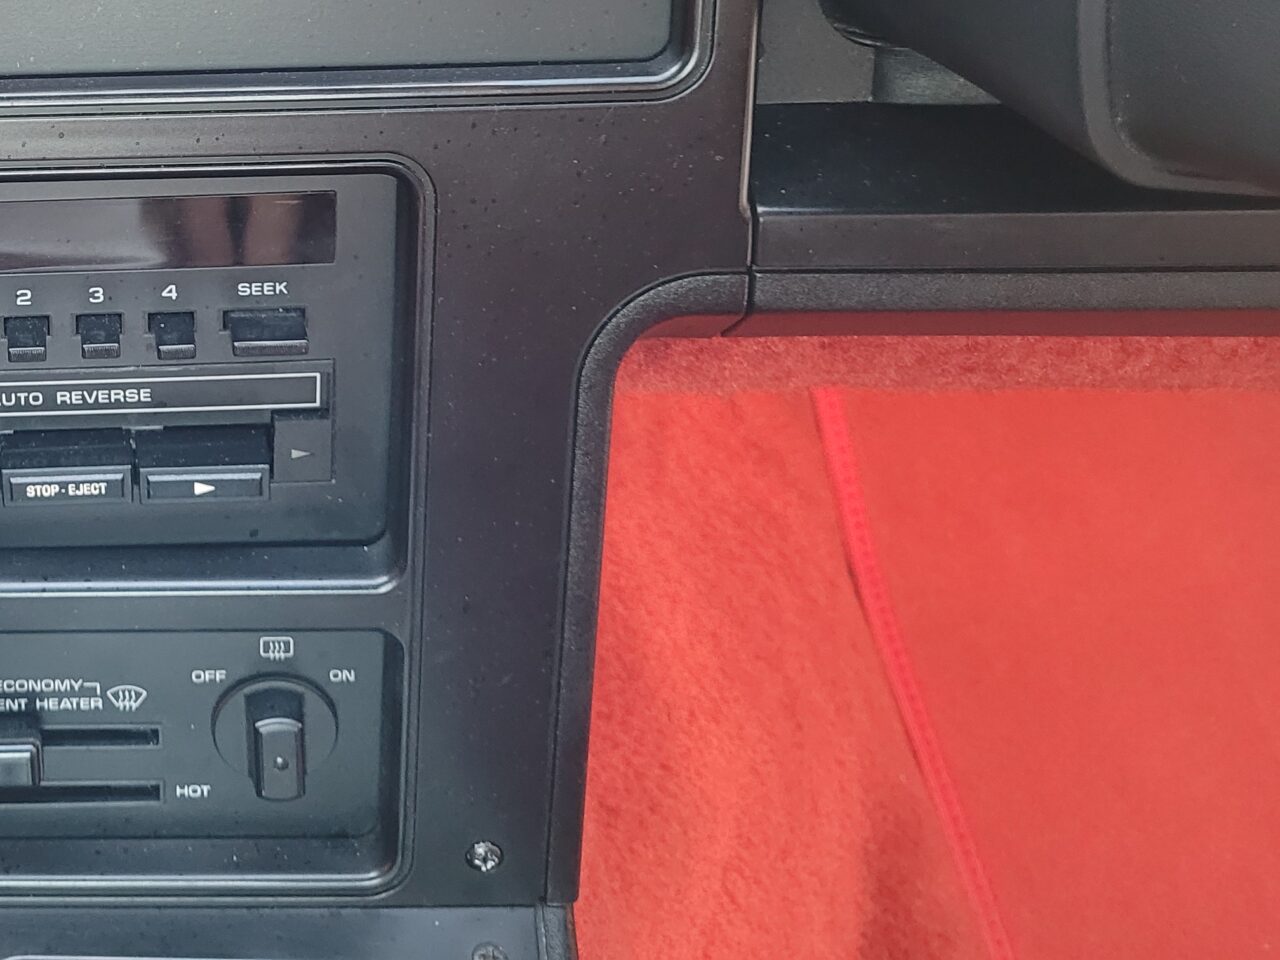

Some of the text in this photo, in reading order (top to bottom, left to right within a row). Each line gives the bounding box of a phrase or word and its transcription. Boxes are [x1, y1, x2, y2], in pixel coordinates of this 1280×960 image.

[16, 290, 32, 306] 2
[88, 287, 104, 303] 3
[161, 284, 178, 301] 4
[237, 282, 289, 297] SEEK
[56, 388, 152, 405] REVERSE
[191, 669, 355, 683] OFF ON
[35, 697, 103, 711] HEATER
[175, 784, 211, 798] HOT
